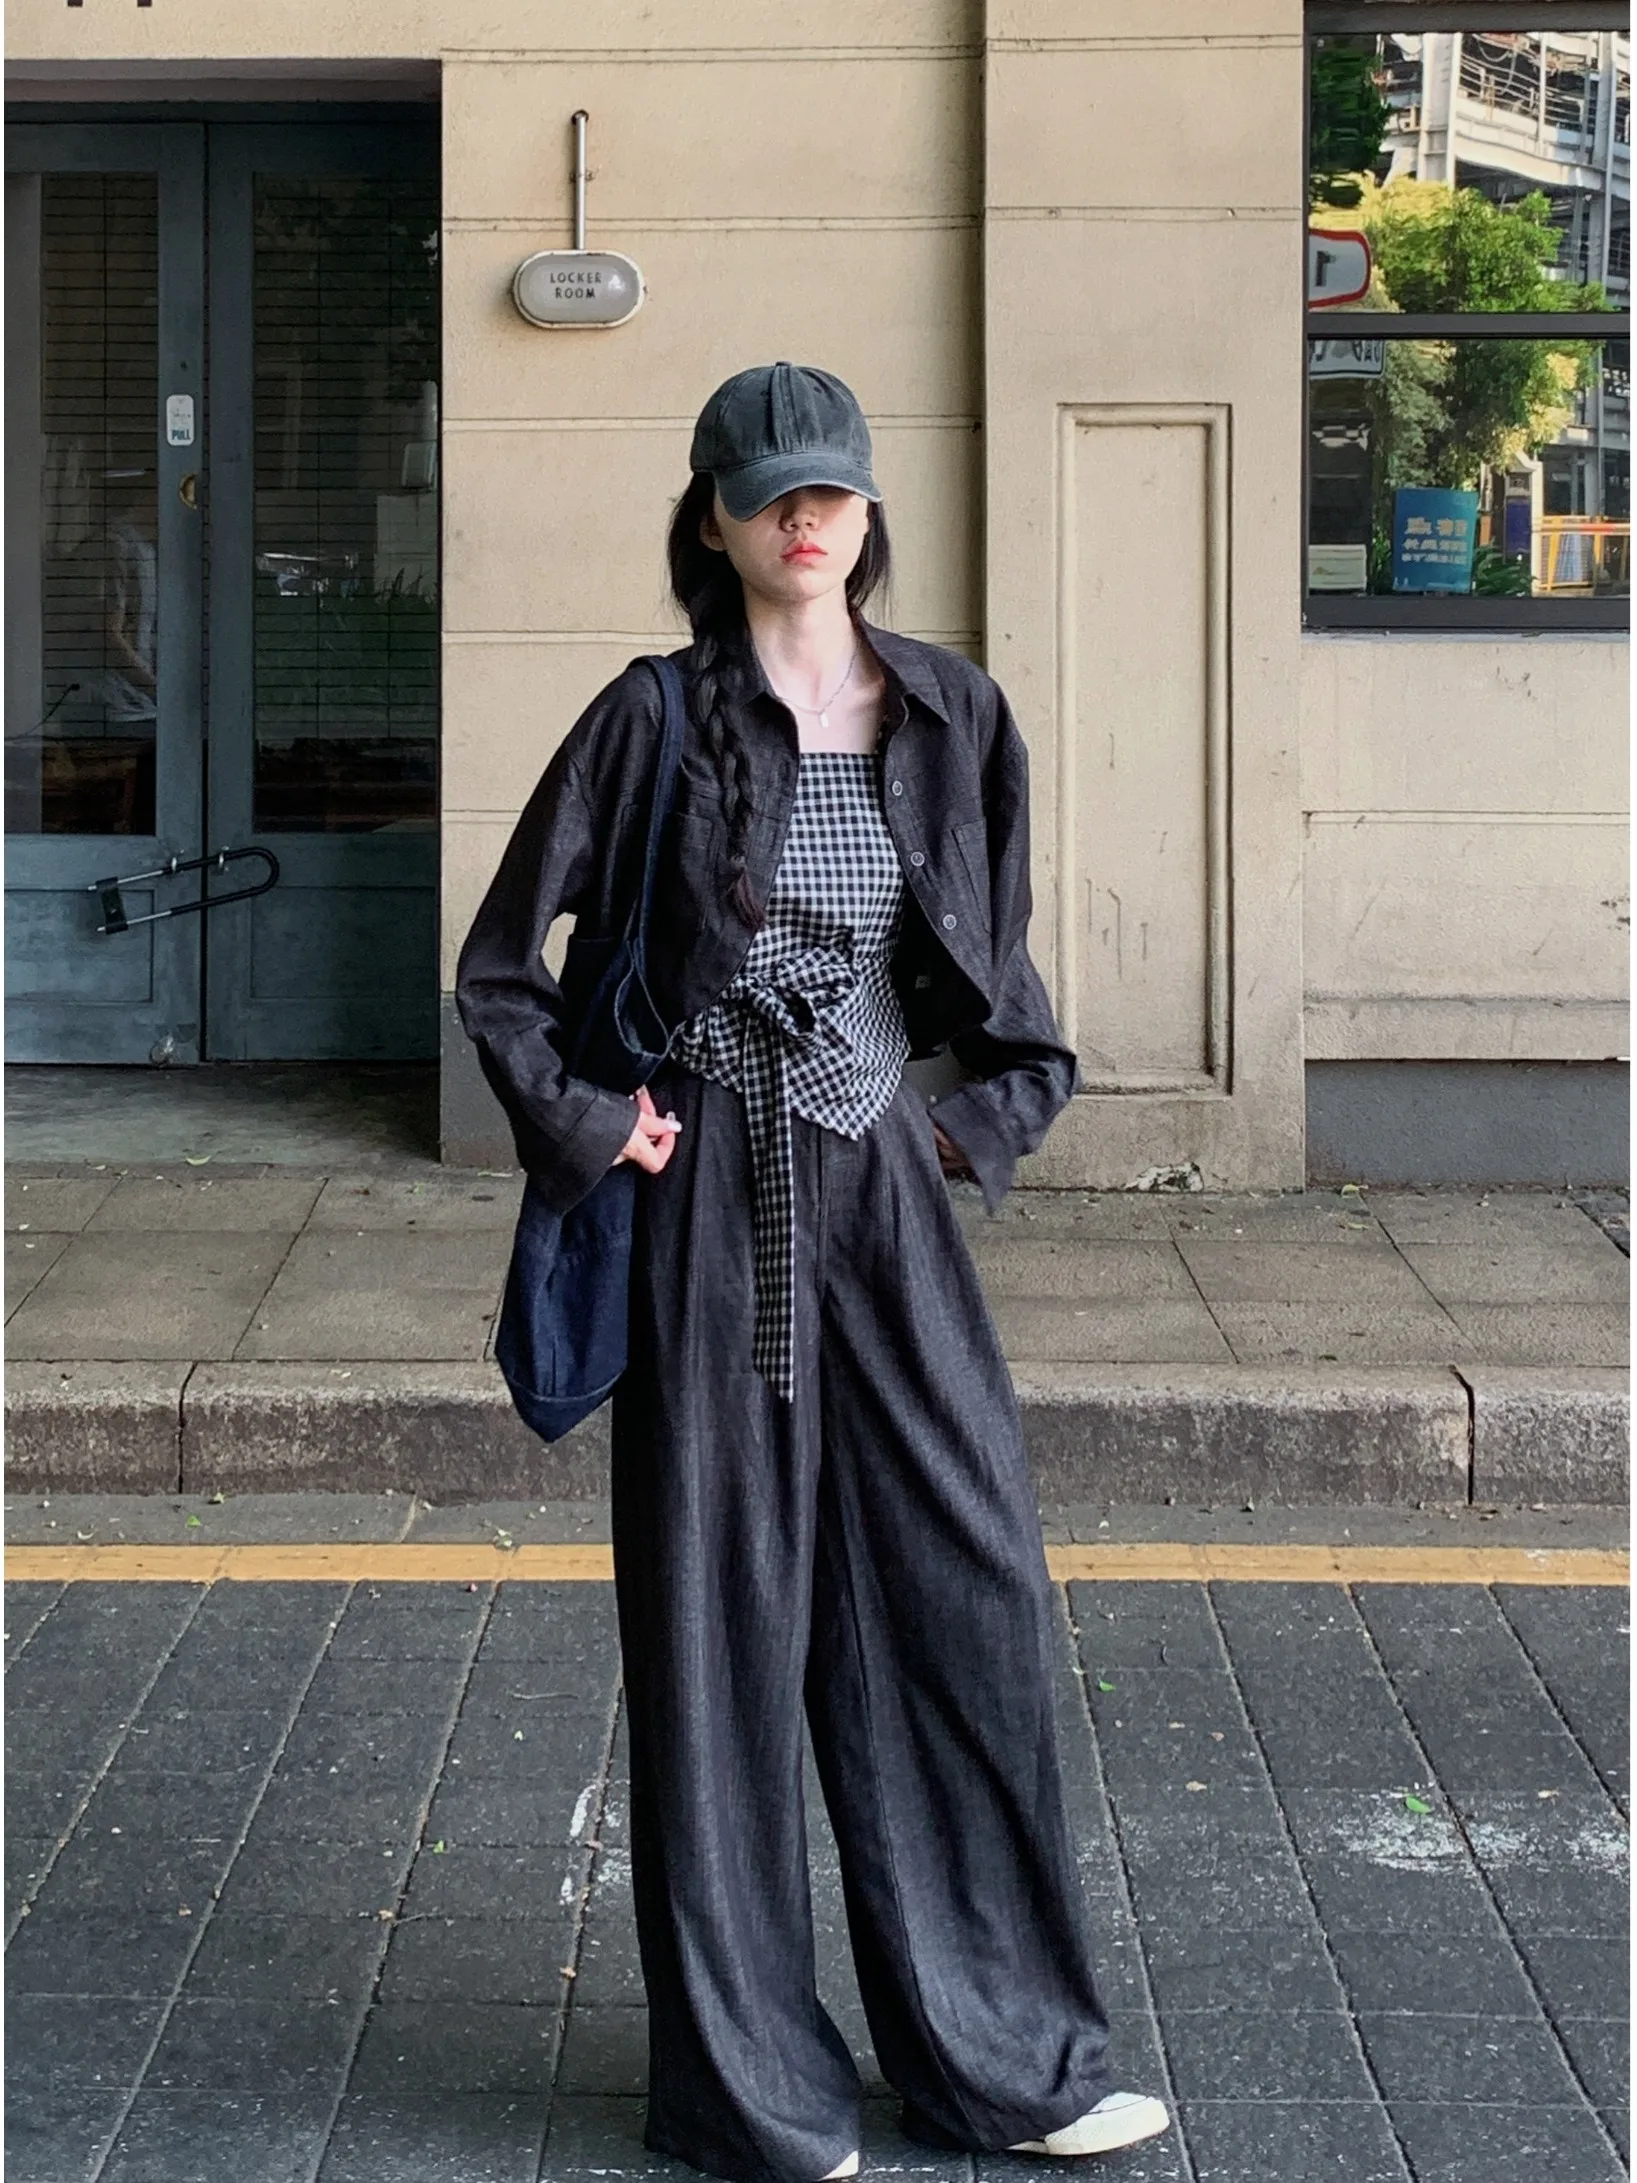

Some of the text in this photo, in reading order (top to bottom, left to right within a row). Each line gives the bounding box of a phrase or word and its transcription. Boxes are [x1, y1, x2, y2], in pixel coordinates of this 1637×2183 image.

[550, 272, 602, 284] LOCKER
[555, 287, 596, 299] ROOM
[171, 428, 191, 440] PULL
